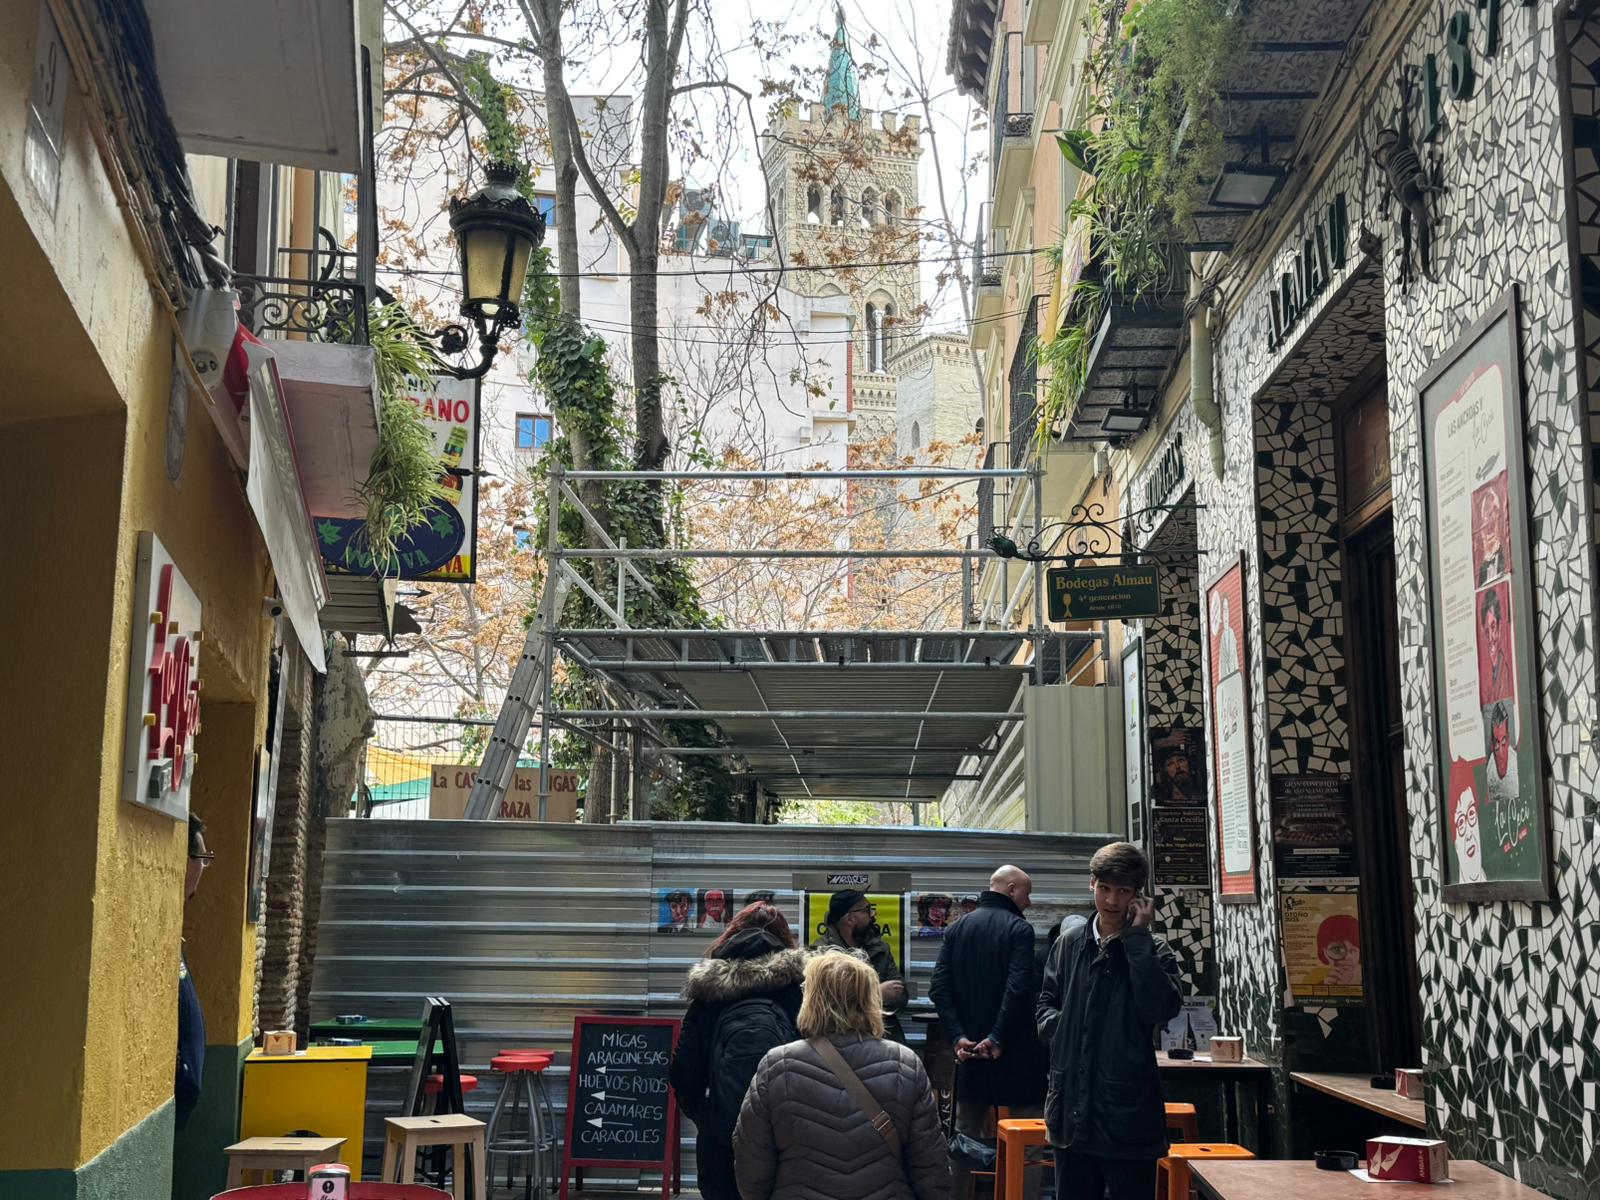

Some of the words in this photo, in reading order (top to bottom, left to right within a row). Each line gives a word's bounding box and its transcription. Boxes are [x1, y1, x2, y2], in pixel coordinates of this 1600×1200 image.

[1268, 192, 1346, 353] ALMAU
[1055, 576, 1109, 590] Bodegas
[1112, 573, 1153, 586] Almau
[432, 771, 448, 788] La
[455, 772, 477, 789] CAS
[515, 774, 531, 791] las
[549, 775, 577, 792] IGAS
[497, 801, 531, 818] RAZA
[587, 1050, 669, 1066] ARAGONESAS
[579, 1074, 630, 1091] HUEVOS
[632, 1075, 669, 1094] ROTOS
[584, 1102, 663, 1120] CALAMARES
[581, 1129, 660, 1143] CARACOLES
